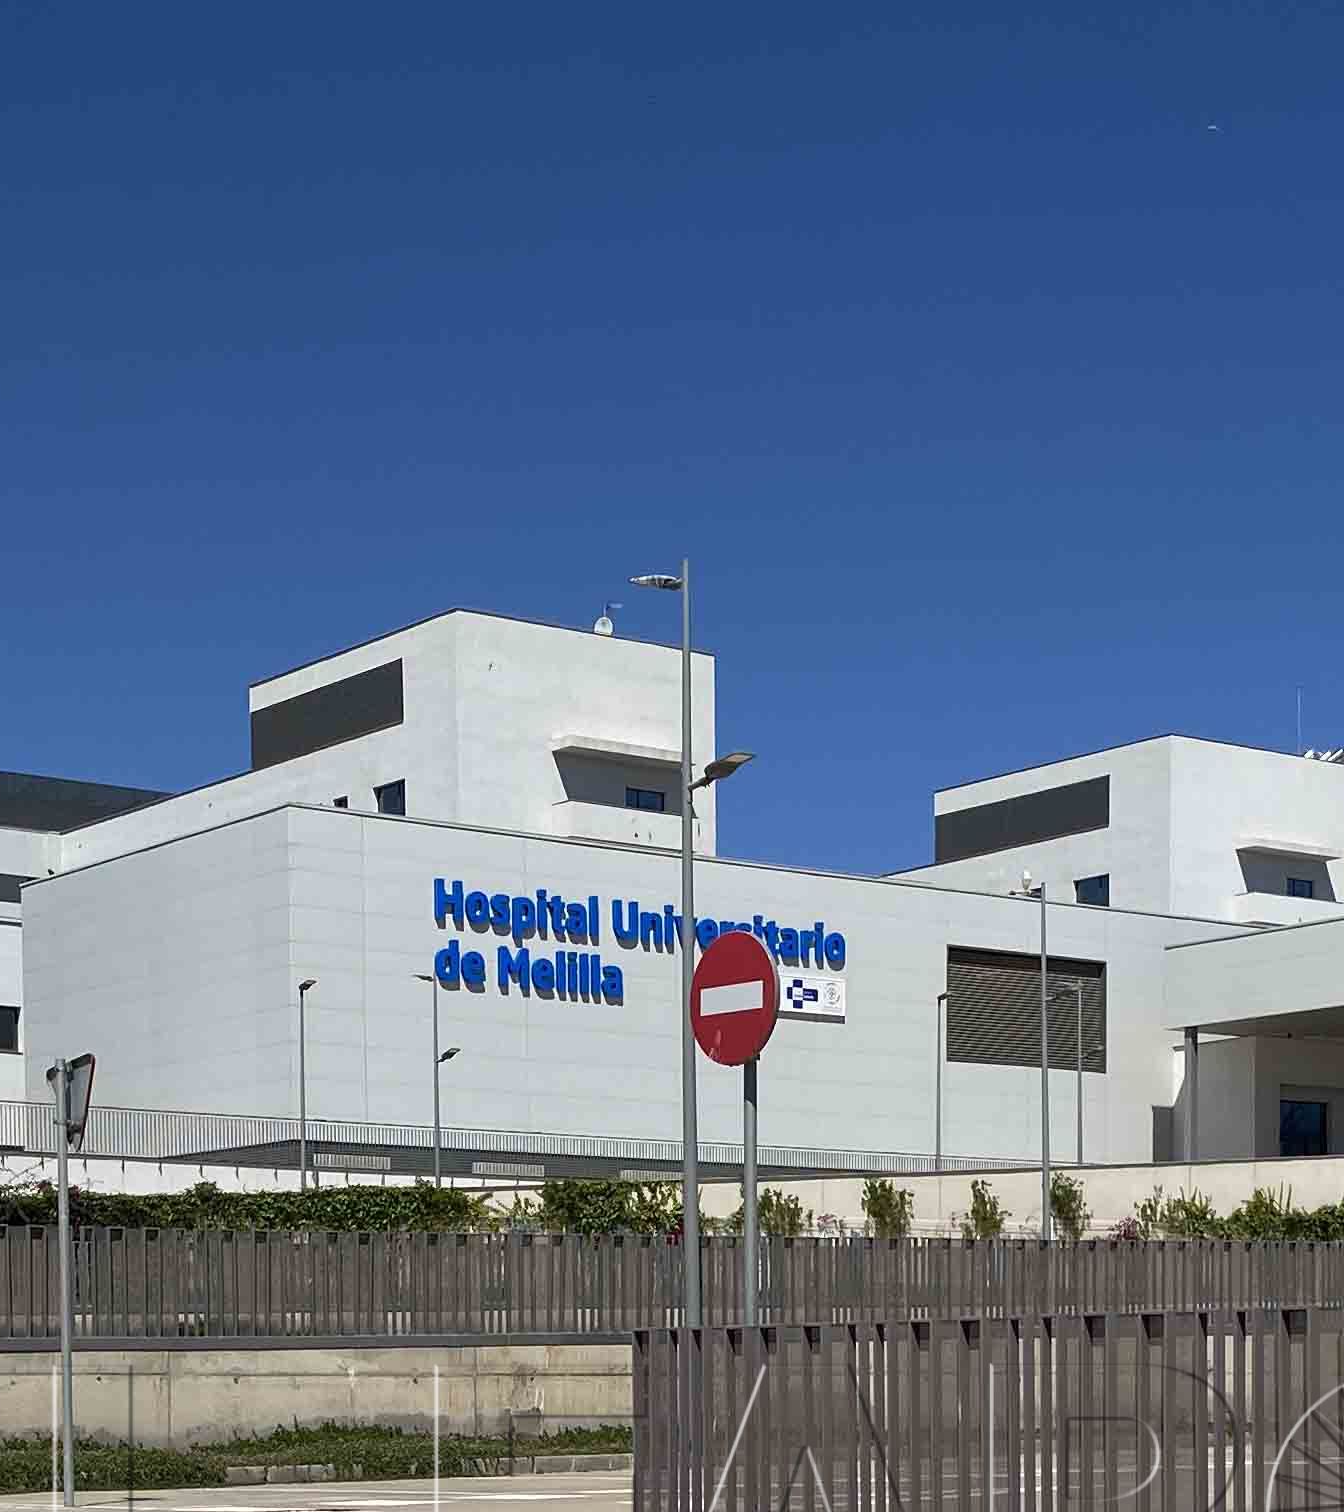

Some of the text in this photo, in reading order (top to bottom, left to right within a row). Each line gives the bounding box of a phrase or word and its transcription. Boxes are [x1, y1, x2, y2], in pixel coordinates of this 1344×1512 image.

[433, 877, 847, 971] Hospital Unieitario
[434, 939, 624, 1006] de Melilla
